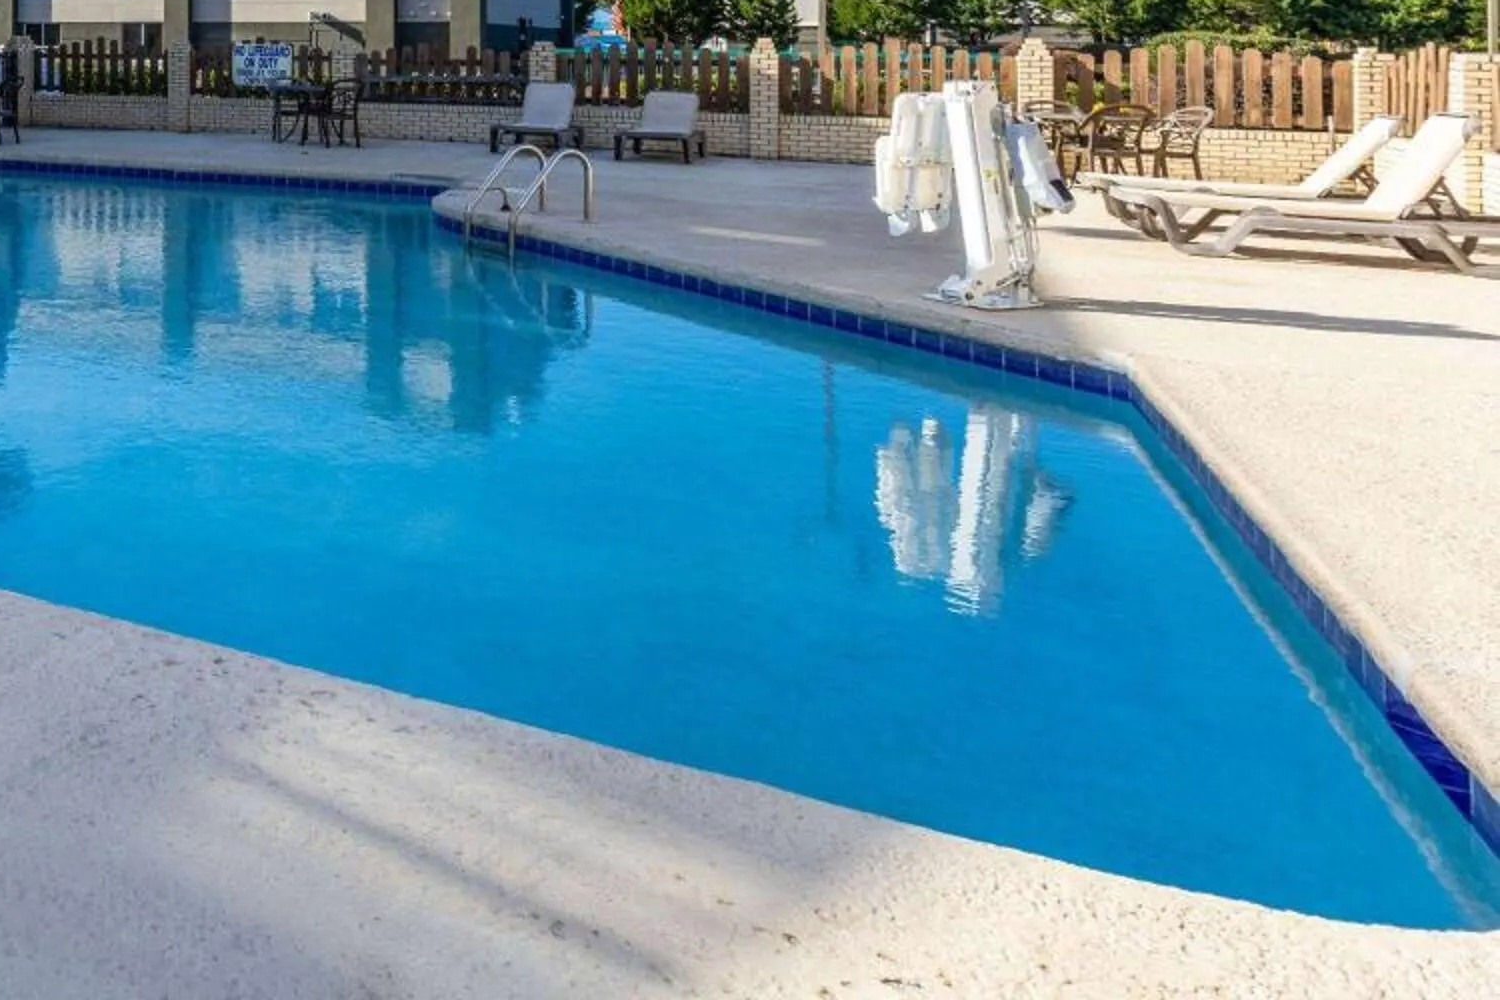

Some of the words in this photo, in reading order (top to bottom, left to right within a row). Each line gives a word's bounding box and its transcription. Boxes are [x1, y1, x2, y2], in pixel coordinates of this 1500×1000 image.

[234, 47, 245, 57] NO
[247, 46, 291, 57] LIFEGUARD
[244, 58, 256, 68] ON
[258, 58, 278, 68] DUTY
